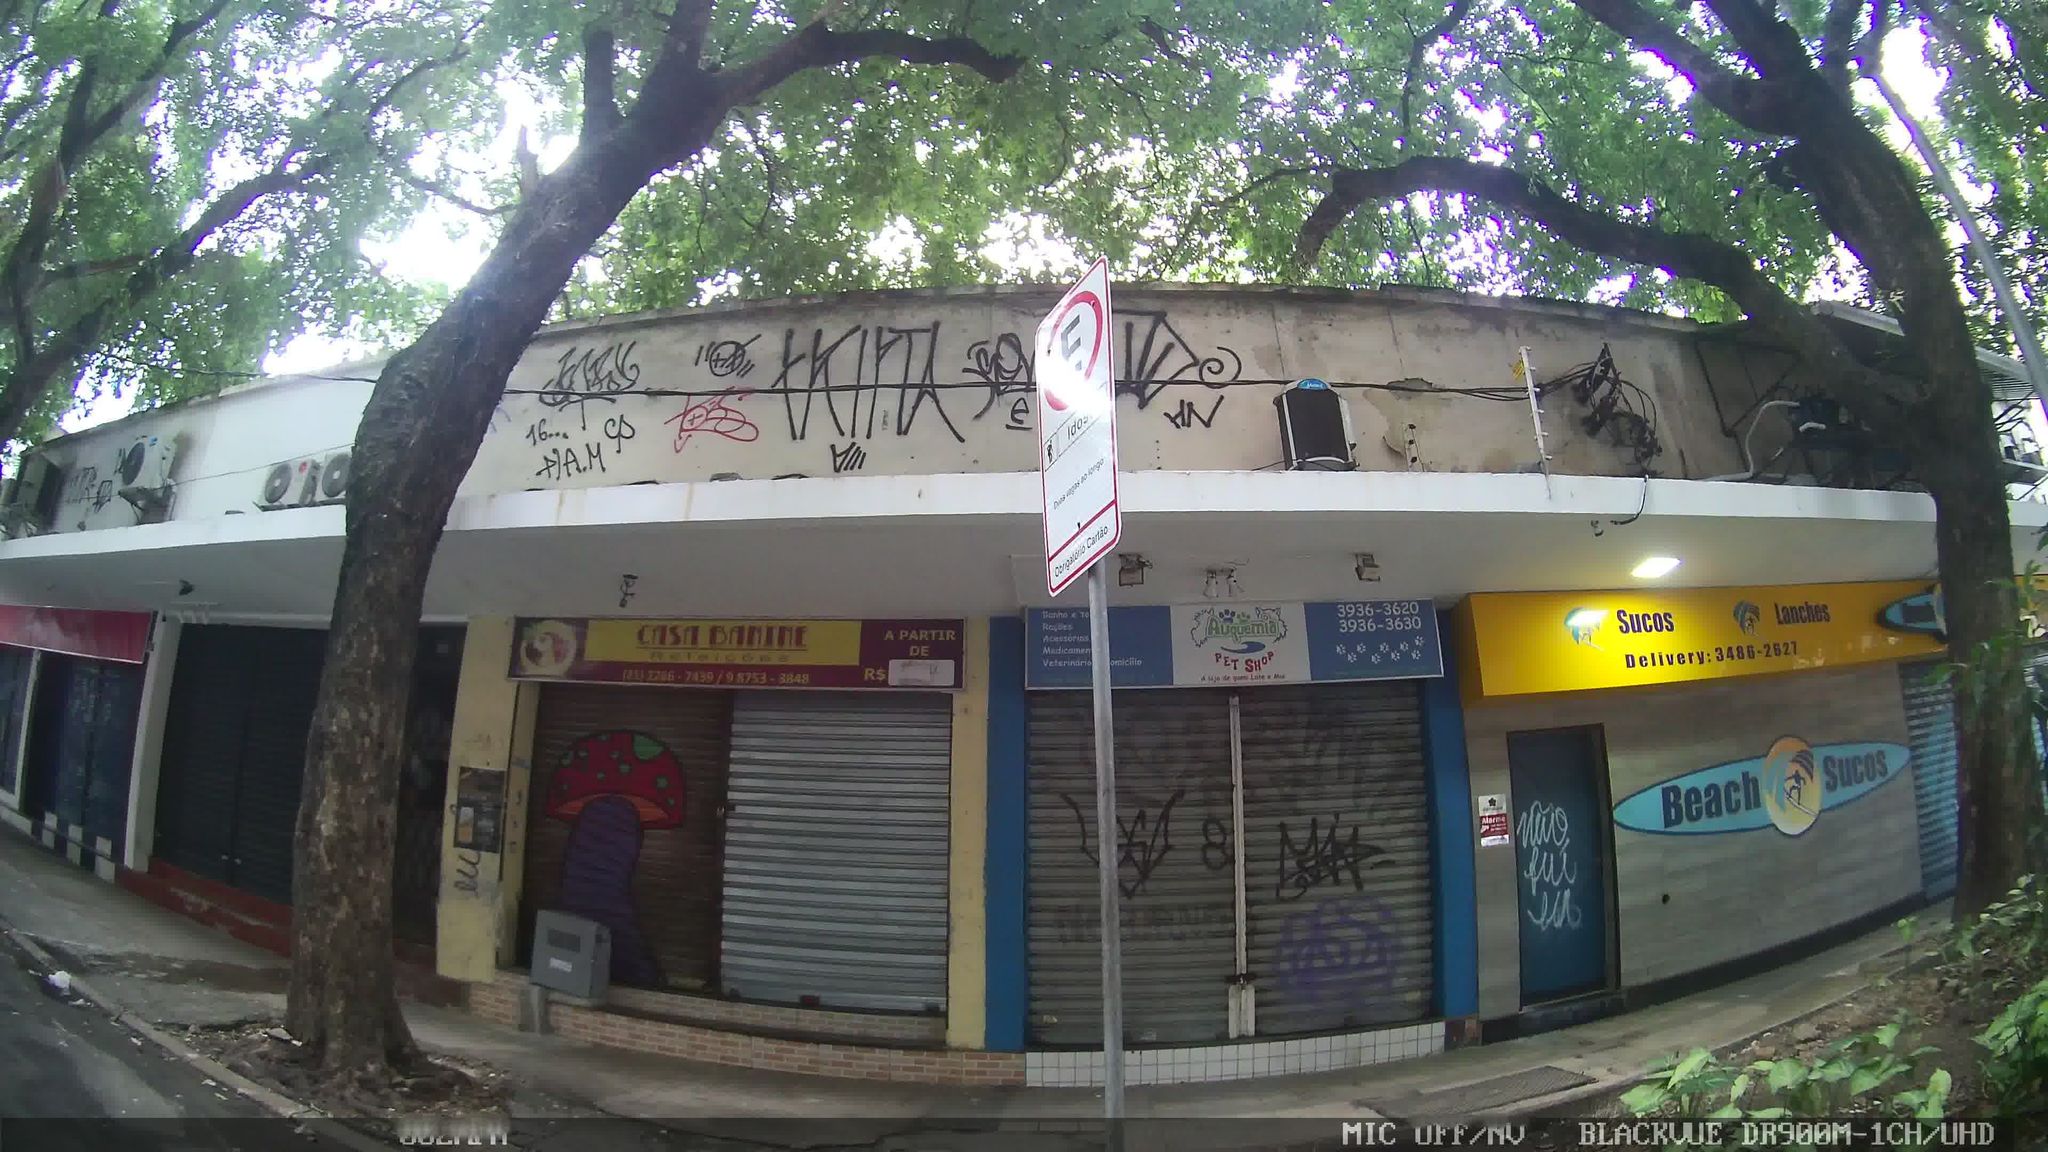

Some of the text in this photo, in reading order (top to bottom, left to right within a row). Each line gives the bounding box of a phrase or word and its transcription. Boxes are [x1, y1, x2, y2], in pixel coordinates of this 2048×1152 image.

[1066, 412, 1093, 441] Idos
[1086, 525, 1109, 551] Cartão
[1337, 602, 1419, 617] 3936-3620
[1616, 601, 1831, 634] Sucos Lanches
[637, 624, 700, 645] CASA
[884, 629, 956, 641] A PARTIR
[1339, 616, 1422, 633] 3936-3630
[909, 646, 930, 656] DE
[1042, 646, 1093, 655] Medicamen
[1625, 641, 1799, 669] Delivery: 3486-2627
[1215, 651, 1274, 672] PET SHOP
[864, 667, 886, 682] R$
[1661, 750, 1890, 829] Beach Sucos
